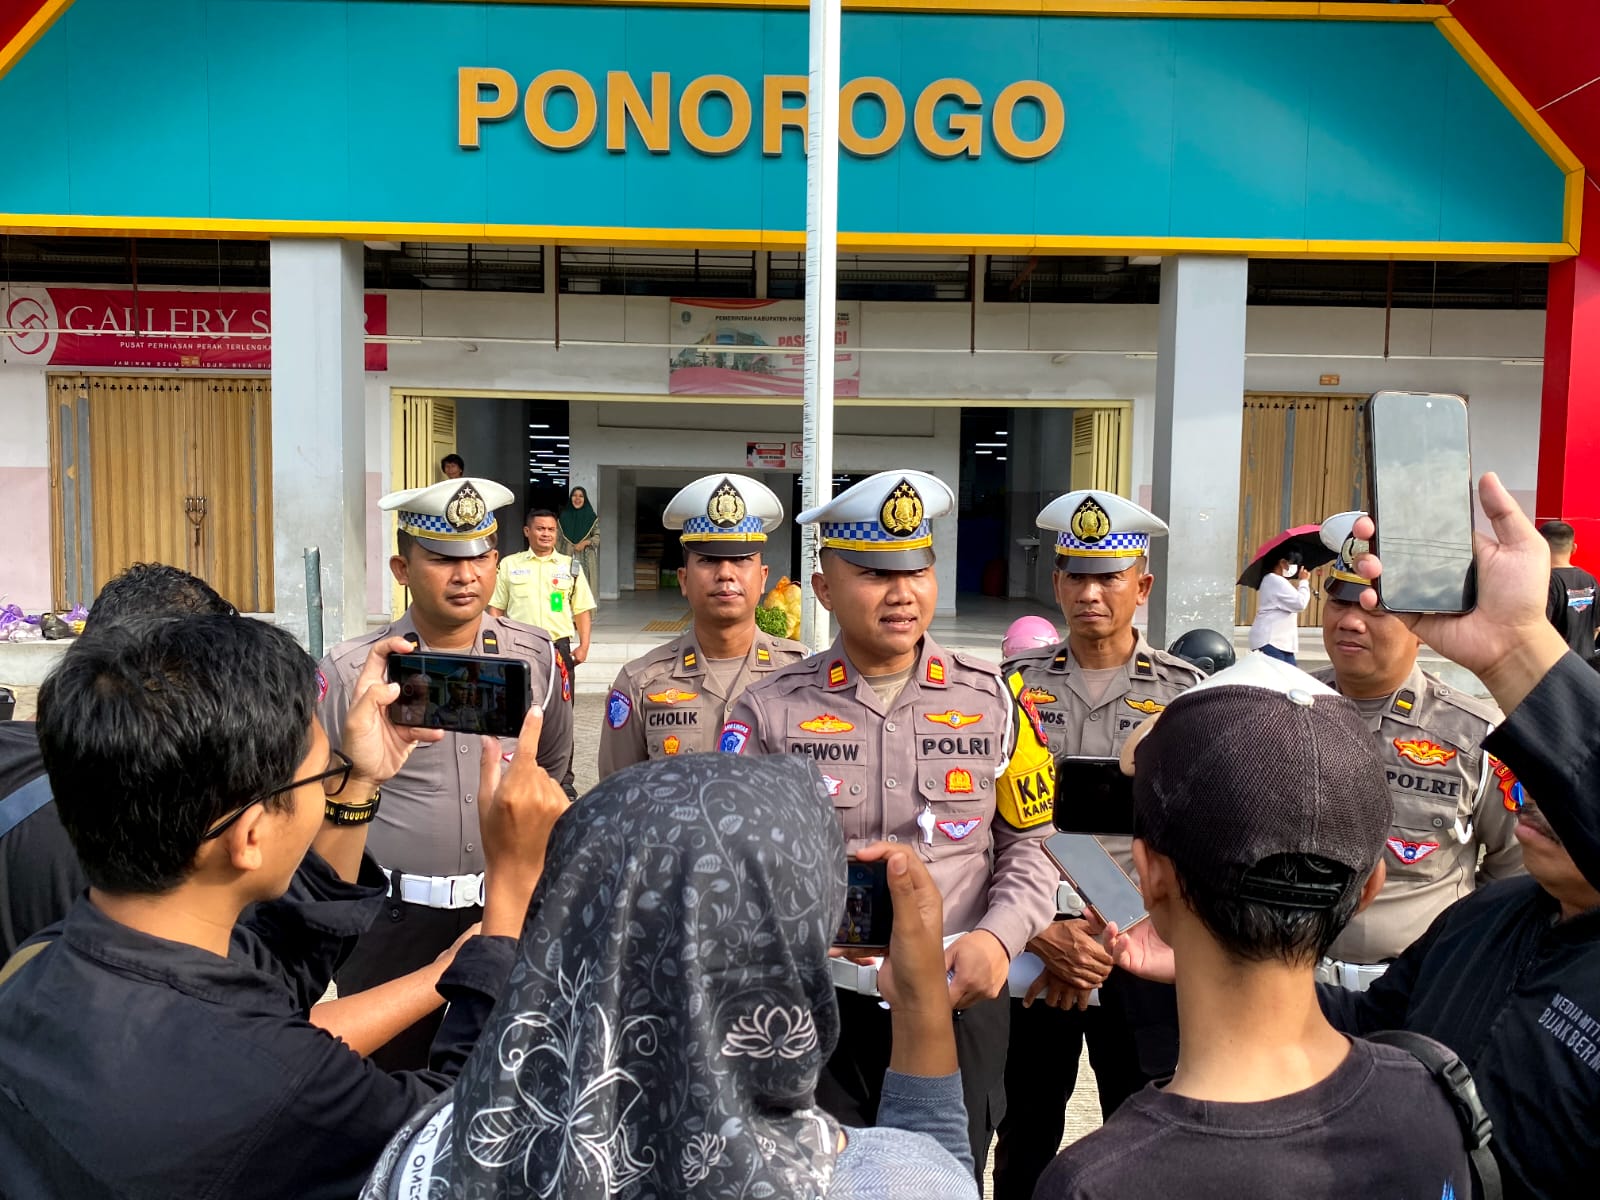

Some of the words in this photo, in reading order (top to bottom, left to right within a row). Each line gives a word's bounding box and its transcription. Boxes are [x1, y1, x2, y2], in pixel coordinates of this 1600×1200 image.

[457, 66, 1066, 162] PONOROGO
[65, 306, 238, 339] GALLERY
[120, 341, 145, 349] PUSAT
[147, 342, 193, 350] PERHIASAN
[649, 711, 698, 726] CHOLIK
[923, 737, 991, 756] POLRI
[1386, 770, 1460, 797] POLRI
[1538, 1007, 1574, 1042] BIJAK
[1551, 993, 1584, 1022] MEDIA
[1578, 1014, 1600, 1042] MIT
